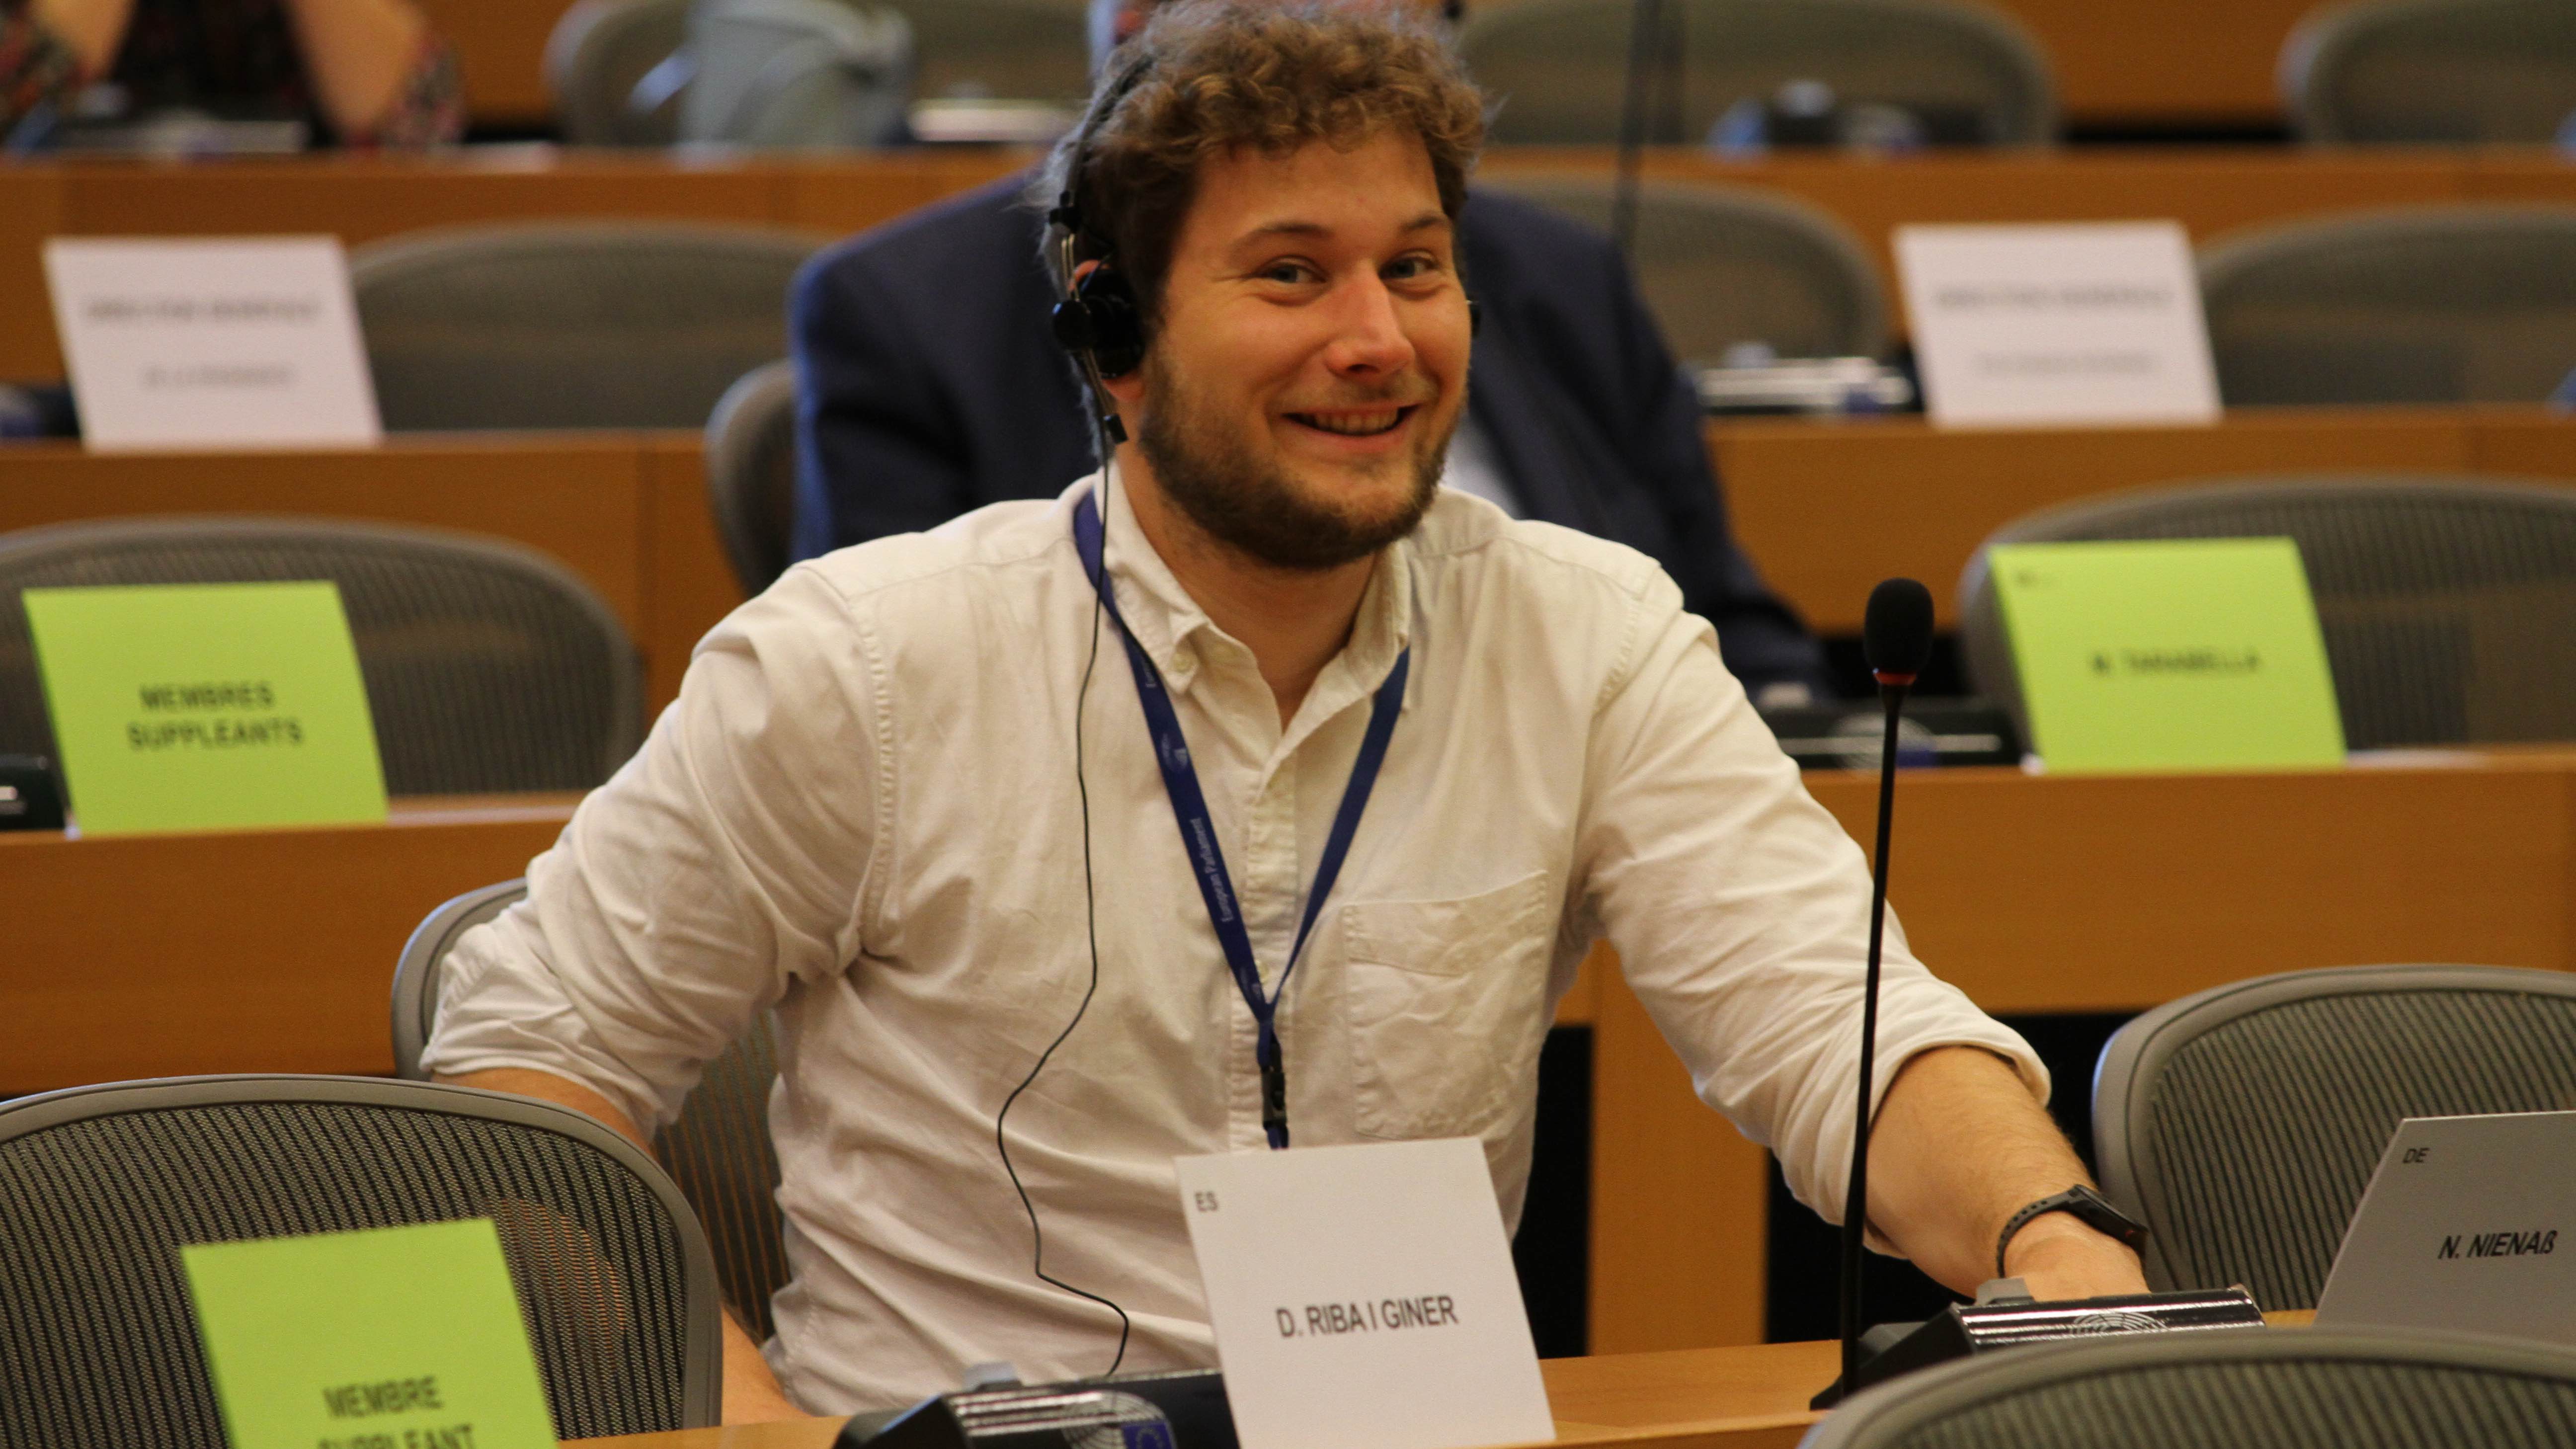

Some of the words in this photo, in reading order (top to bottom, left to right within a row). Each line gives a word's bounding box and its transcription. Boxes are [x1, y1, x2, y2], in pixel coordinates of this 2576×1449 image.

[139, 681, 275, 712] MEMBRES
[127, 717, 304, 750] SUPPLEANTS
[1190, 817, 1218, 874] Parliament
[1209, 873, 1234, 922] European
[2402, 1147, 2430, 1164] DE
[1194, 1191, 1219, 1212] ES
[2437, 1235, 2461, 1259] N.
[1276, 1306, 1304, 1338] D.
[1305, 1301, 1368, 1336] RIBA
[1367, 1300, 1378, 1330] I
[1380, 1295, 1459, 1330] GINER
[322, 1375, 444, 1420] MEMBRE
